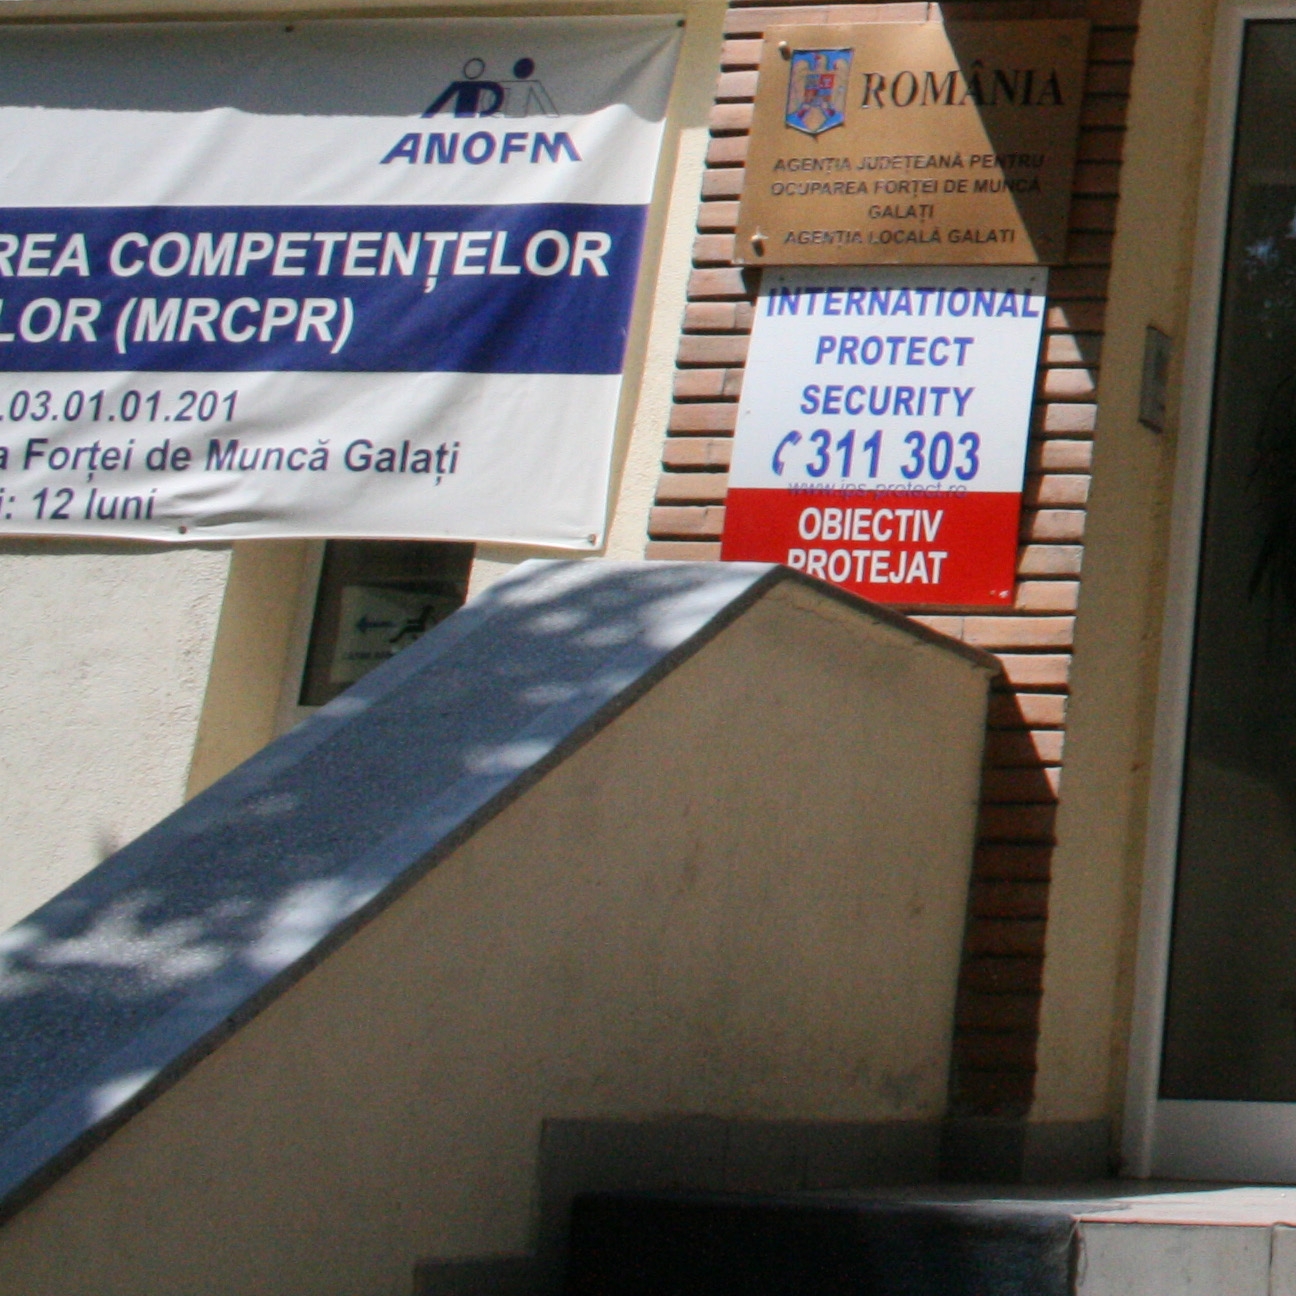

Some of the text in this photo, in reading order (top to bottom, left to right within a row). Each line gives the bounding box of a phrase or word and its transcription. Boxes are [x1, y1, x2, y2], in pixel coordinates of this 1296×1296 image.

[861, 60, 1064, 108] ROMÂNIA
[379, 130, 583, 165] ANOFM
[969, 151, 1044, 170] PENTRU
[770, 179, 868, 196] OCUPAREA
[943, 178, 967, 194] DE
[109, 229, 612, 294] COMPETENȚELOR
[766, 287, 1041, 318] INTERNATIONAL
[115, 296, 354, 354] (MRCPR)
[815, 335, 975, 367] PROTECT
[800, 384, 976, 417] SECURITY
[23, 437, 136, 483] Forței
[146, 438, 192, 471] de
[205, 438, 331, 472] Muncă
[344, 438, 461, 486] Galați
[806, 428, 981, 481] 311 303
[32, 487, 75, 520] 12
[84, 487, 158, 520] luni
[799, 507, 944, 542] OBIECTIV
[787, 548, 948, 585] PROTEJAT
